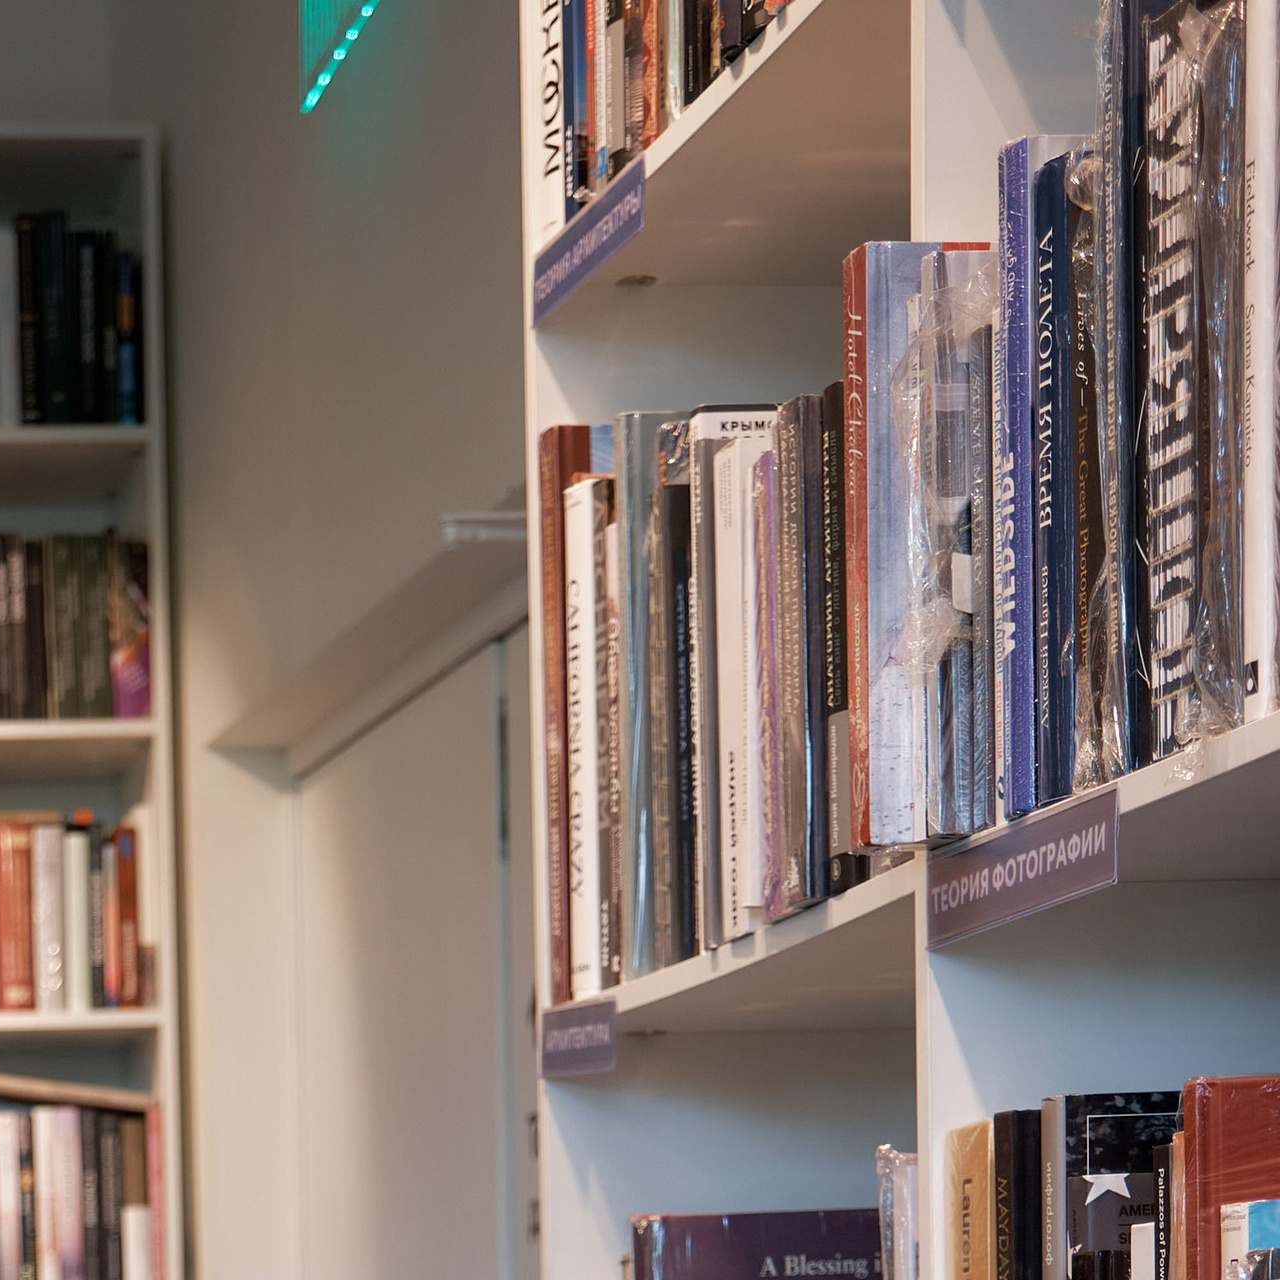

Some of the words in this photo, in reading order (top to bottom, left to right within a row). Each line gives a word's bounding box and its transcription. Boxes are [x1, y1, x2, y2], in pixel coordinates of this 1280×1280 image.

[1244, 158, 1256, 275] Fieldwork
[1006, 271, 1015, 301] AND
[1037, 226, 1054, 389] ПОЛЕТА
[1076, 291, 1089, 351] Lives
[1105, 271, 1114, 341] СТАРЫХ
[847, 296, 863, 382] Hotel
[993, 331, 1002, 394] TRADING
[1106, 346, 1114, 373] НА
[1244, 302, 1256, 369] Sanna
[1075, 360, 1089, 387] of
[847, 391, 863, 497] Chelsea
[993, 399, 1002, 459] PLACES
[1077, 408, 1090, 456] The
[1106, 380, 1115, 451] МОСКВА
[1243, 374, 1256, 468] Kannisto
[789, 424, 798, 513] ИСТОРИИ
[993, 462, 1002, 484] THE
[1037, 400, 1054, 528] ВРЕМЯ
[1077, 460, 1090, 527] Great
[822, 430, 833, 583] АРХИТЕКТУРЫ
[994, 490, 1003, 592] MERCHANTS
[1108, 478, 1118, 554] МОСКВЫ
[789, 522, 798, 589] ДОМОВ
[1001, 450, 1017, 661] WILDSIDE
[1109, 561, 1118, 583] ИЗ
[995, 600, 1003, 611] OF
[1039, 565, 1050, 637] Нагаев
[852, 602, 861, 672] VICTORIA
[995, 616, 1004, 668] NAIROBI
[565, 579, 582, 785] CALIFORNIA
[995, 679, 1003, 717] STEVE
[1039, 644, 1050, 729] Алексей
[995, 720, 1003, 760] BLOOM
[568, 791, 583, 899] CRAZY
[830, 802, 839, 848] Сергей
[931, 867, 989, 915] ТЕОРИЯ
[991, 821, 1106, 892] ФОТОГРАФИИ
[961, 1178, 973, 1274] Lauren
[1045, 1161, 1054, 1266] фотографии
[1157, 1168, 1165, 1230] Palazzos
[759, 1255, 779, 1277] A
[783, 1252, 869, 1279] Blessing
[1158, 1231, 1166, 1246] of
